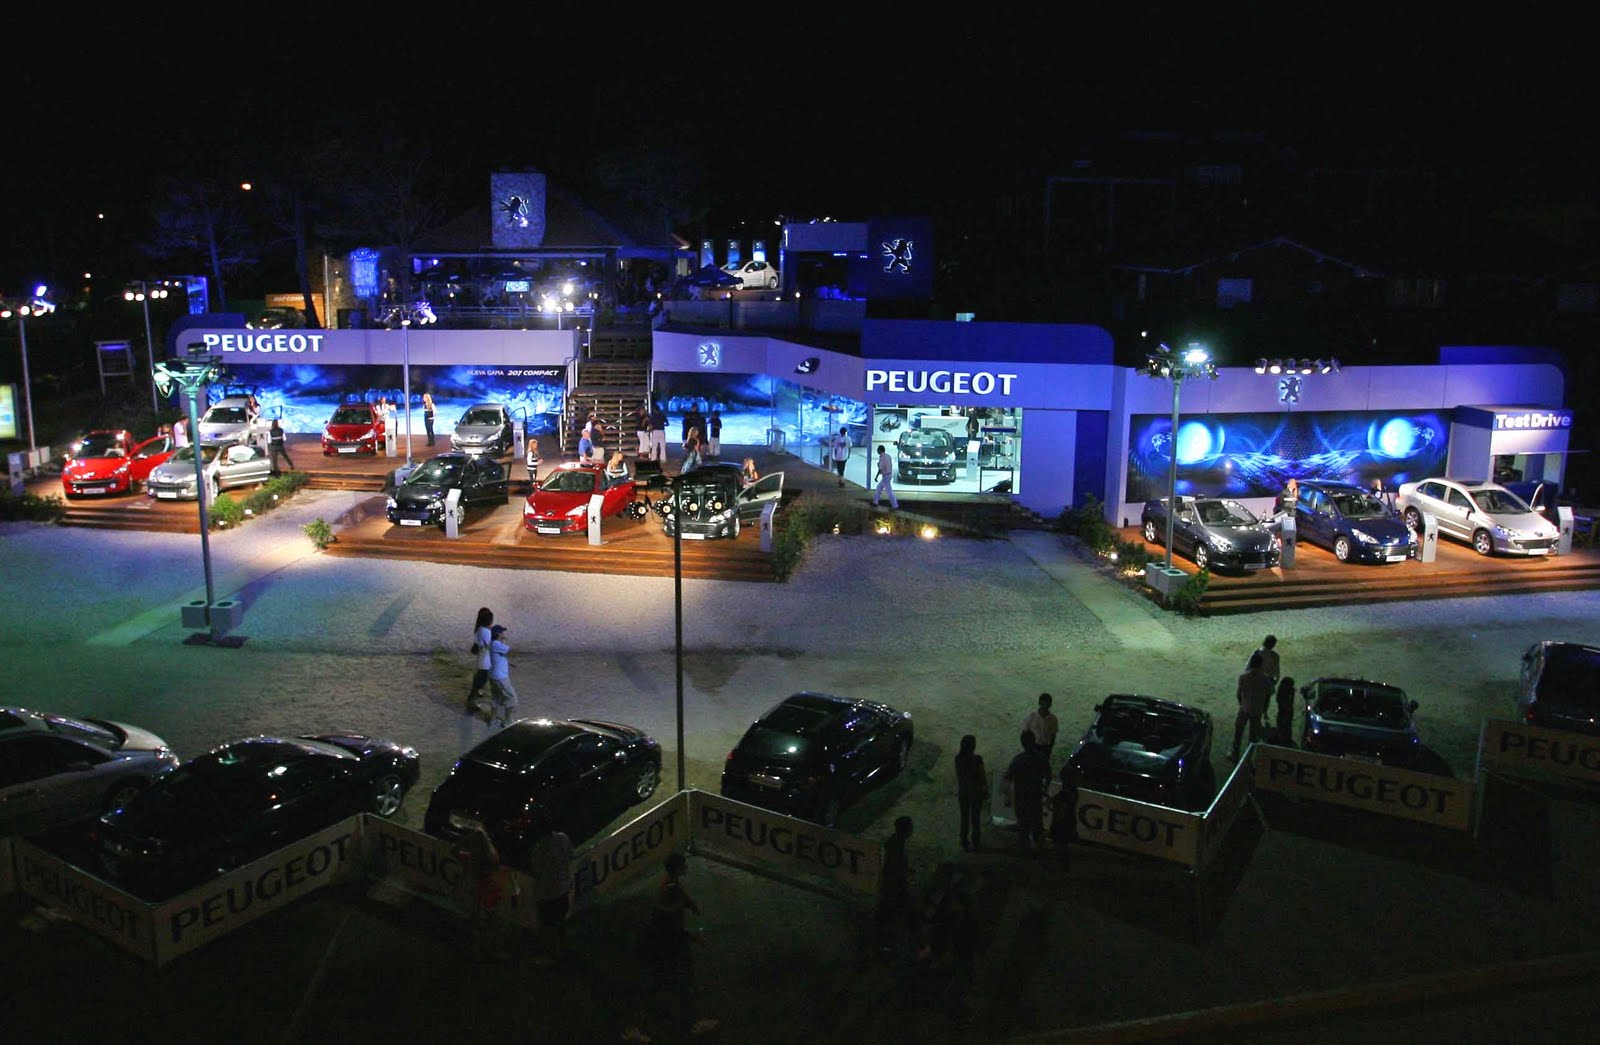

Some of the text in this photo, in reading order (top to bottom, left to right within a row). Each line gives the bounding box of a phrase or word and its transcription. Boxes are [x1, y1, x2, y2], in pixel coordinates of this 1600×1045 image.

[203, 333, 323, 352] PEUGEOT
[866, 370, 1017, 395] PEUGEOT
[1269, 759, 1454, 813] PEUGEOT
[575, 810, 678, 893] EUGEOT
[702, 806, 865, 873] PEUGEOT
[1079, 804, 1183, 846] GEOT
[381, 834, 462, 885] PEUG
[24, 857, 138, 938] PEUGEOT
[171, 834, 351, 942] PEUGEOT
